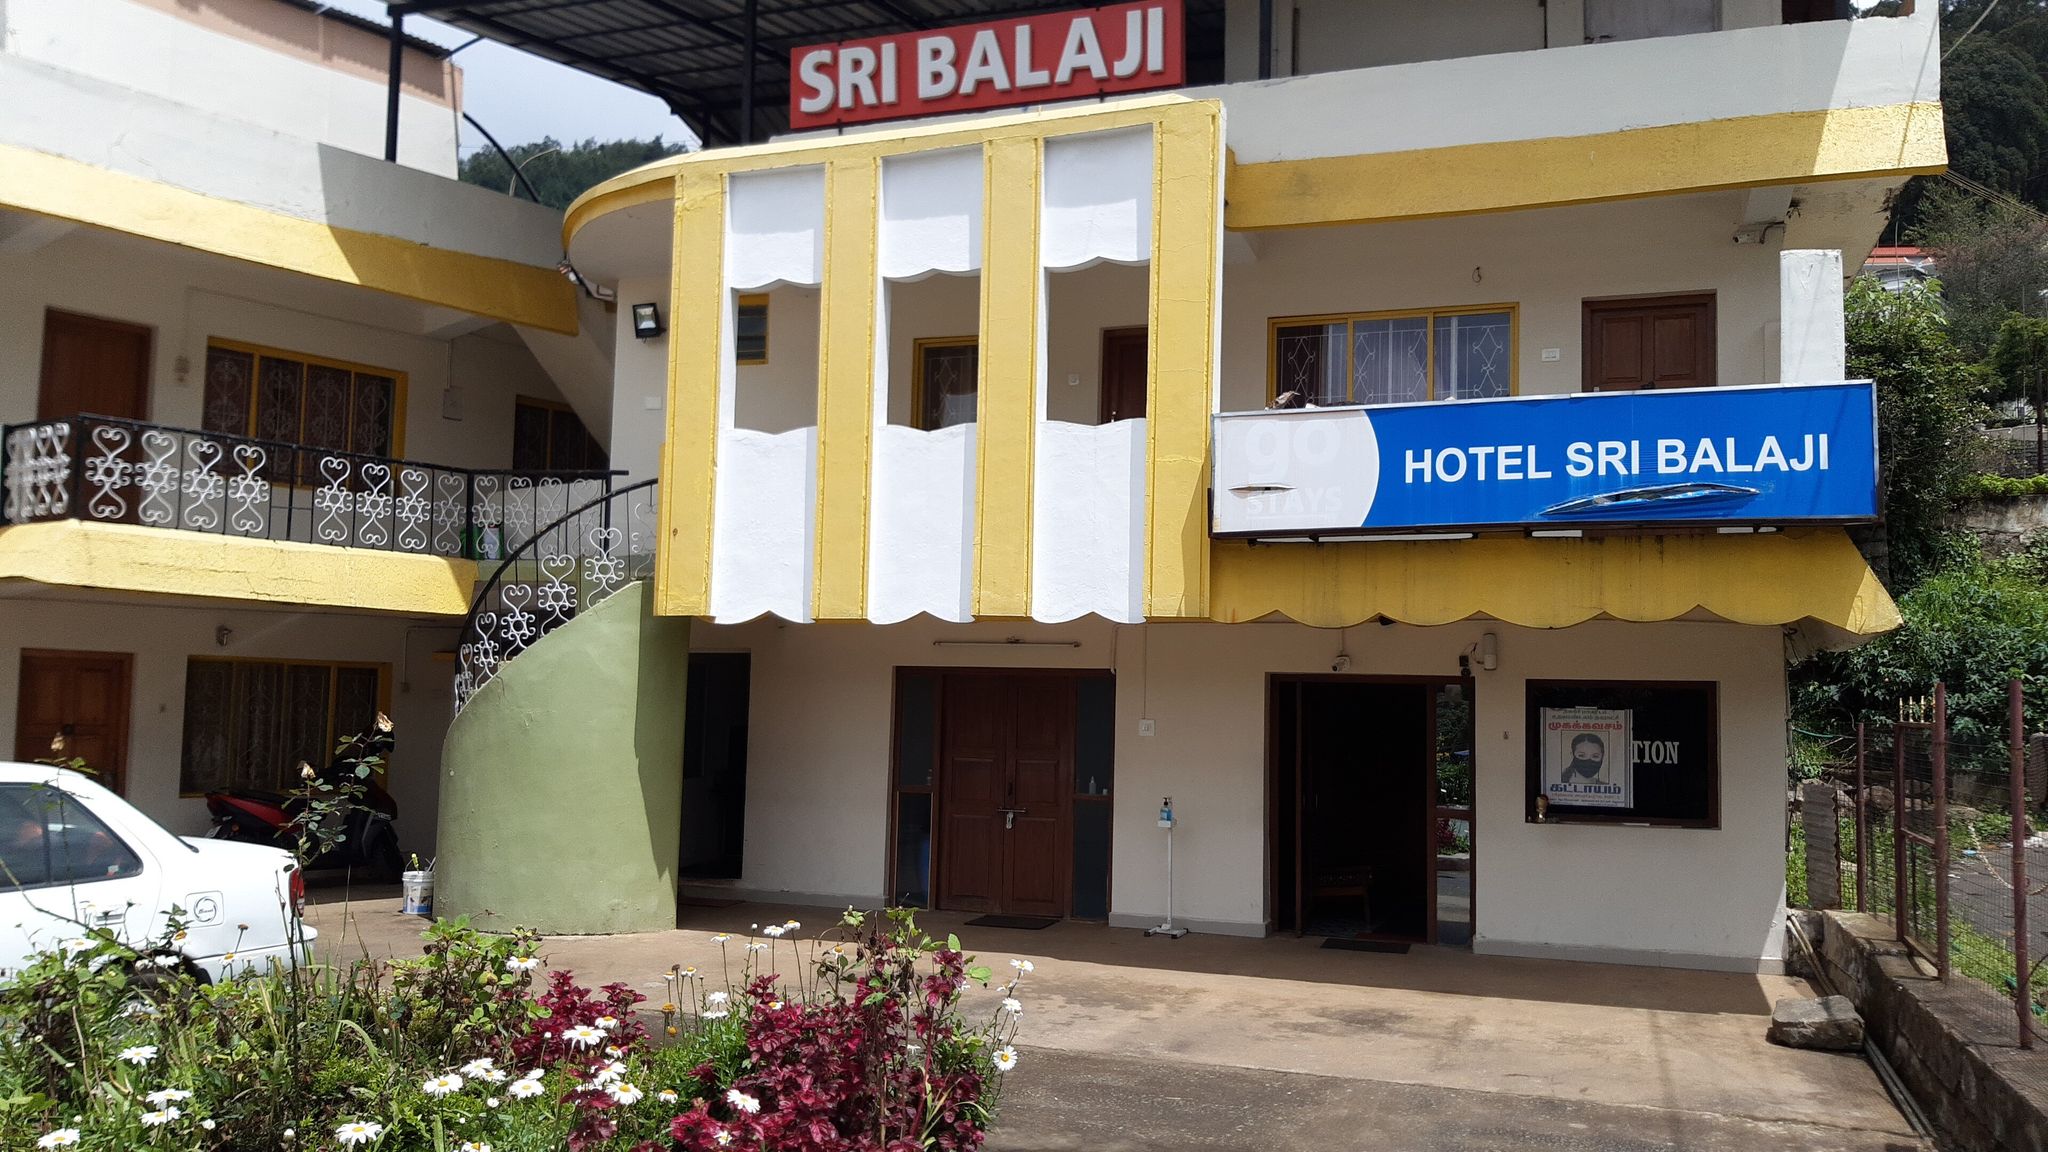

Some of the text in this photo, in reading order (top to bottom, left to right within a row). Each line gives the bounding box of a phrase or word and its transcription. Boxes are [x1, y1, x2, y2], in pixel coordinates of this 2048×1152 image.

[799, 6, 1165, 115] SRI BALAJI
[1246, 420, 1342, 483] go
[1404, 433, 1830, 484] HOTEL SRI BALAJI
[1548, 720, 1623, 731] முகக்கவசம்
[1550, 783, 1621, 795] கட்டாயம்
